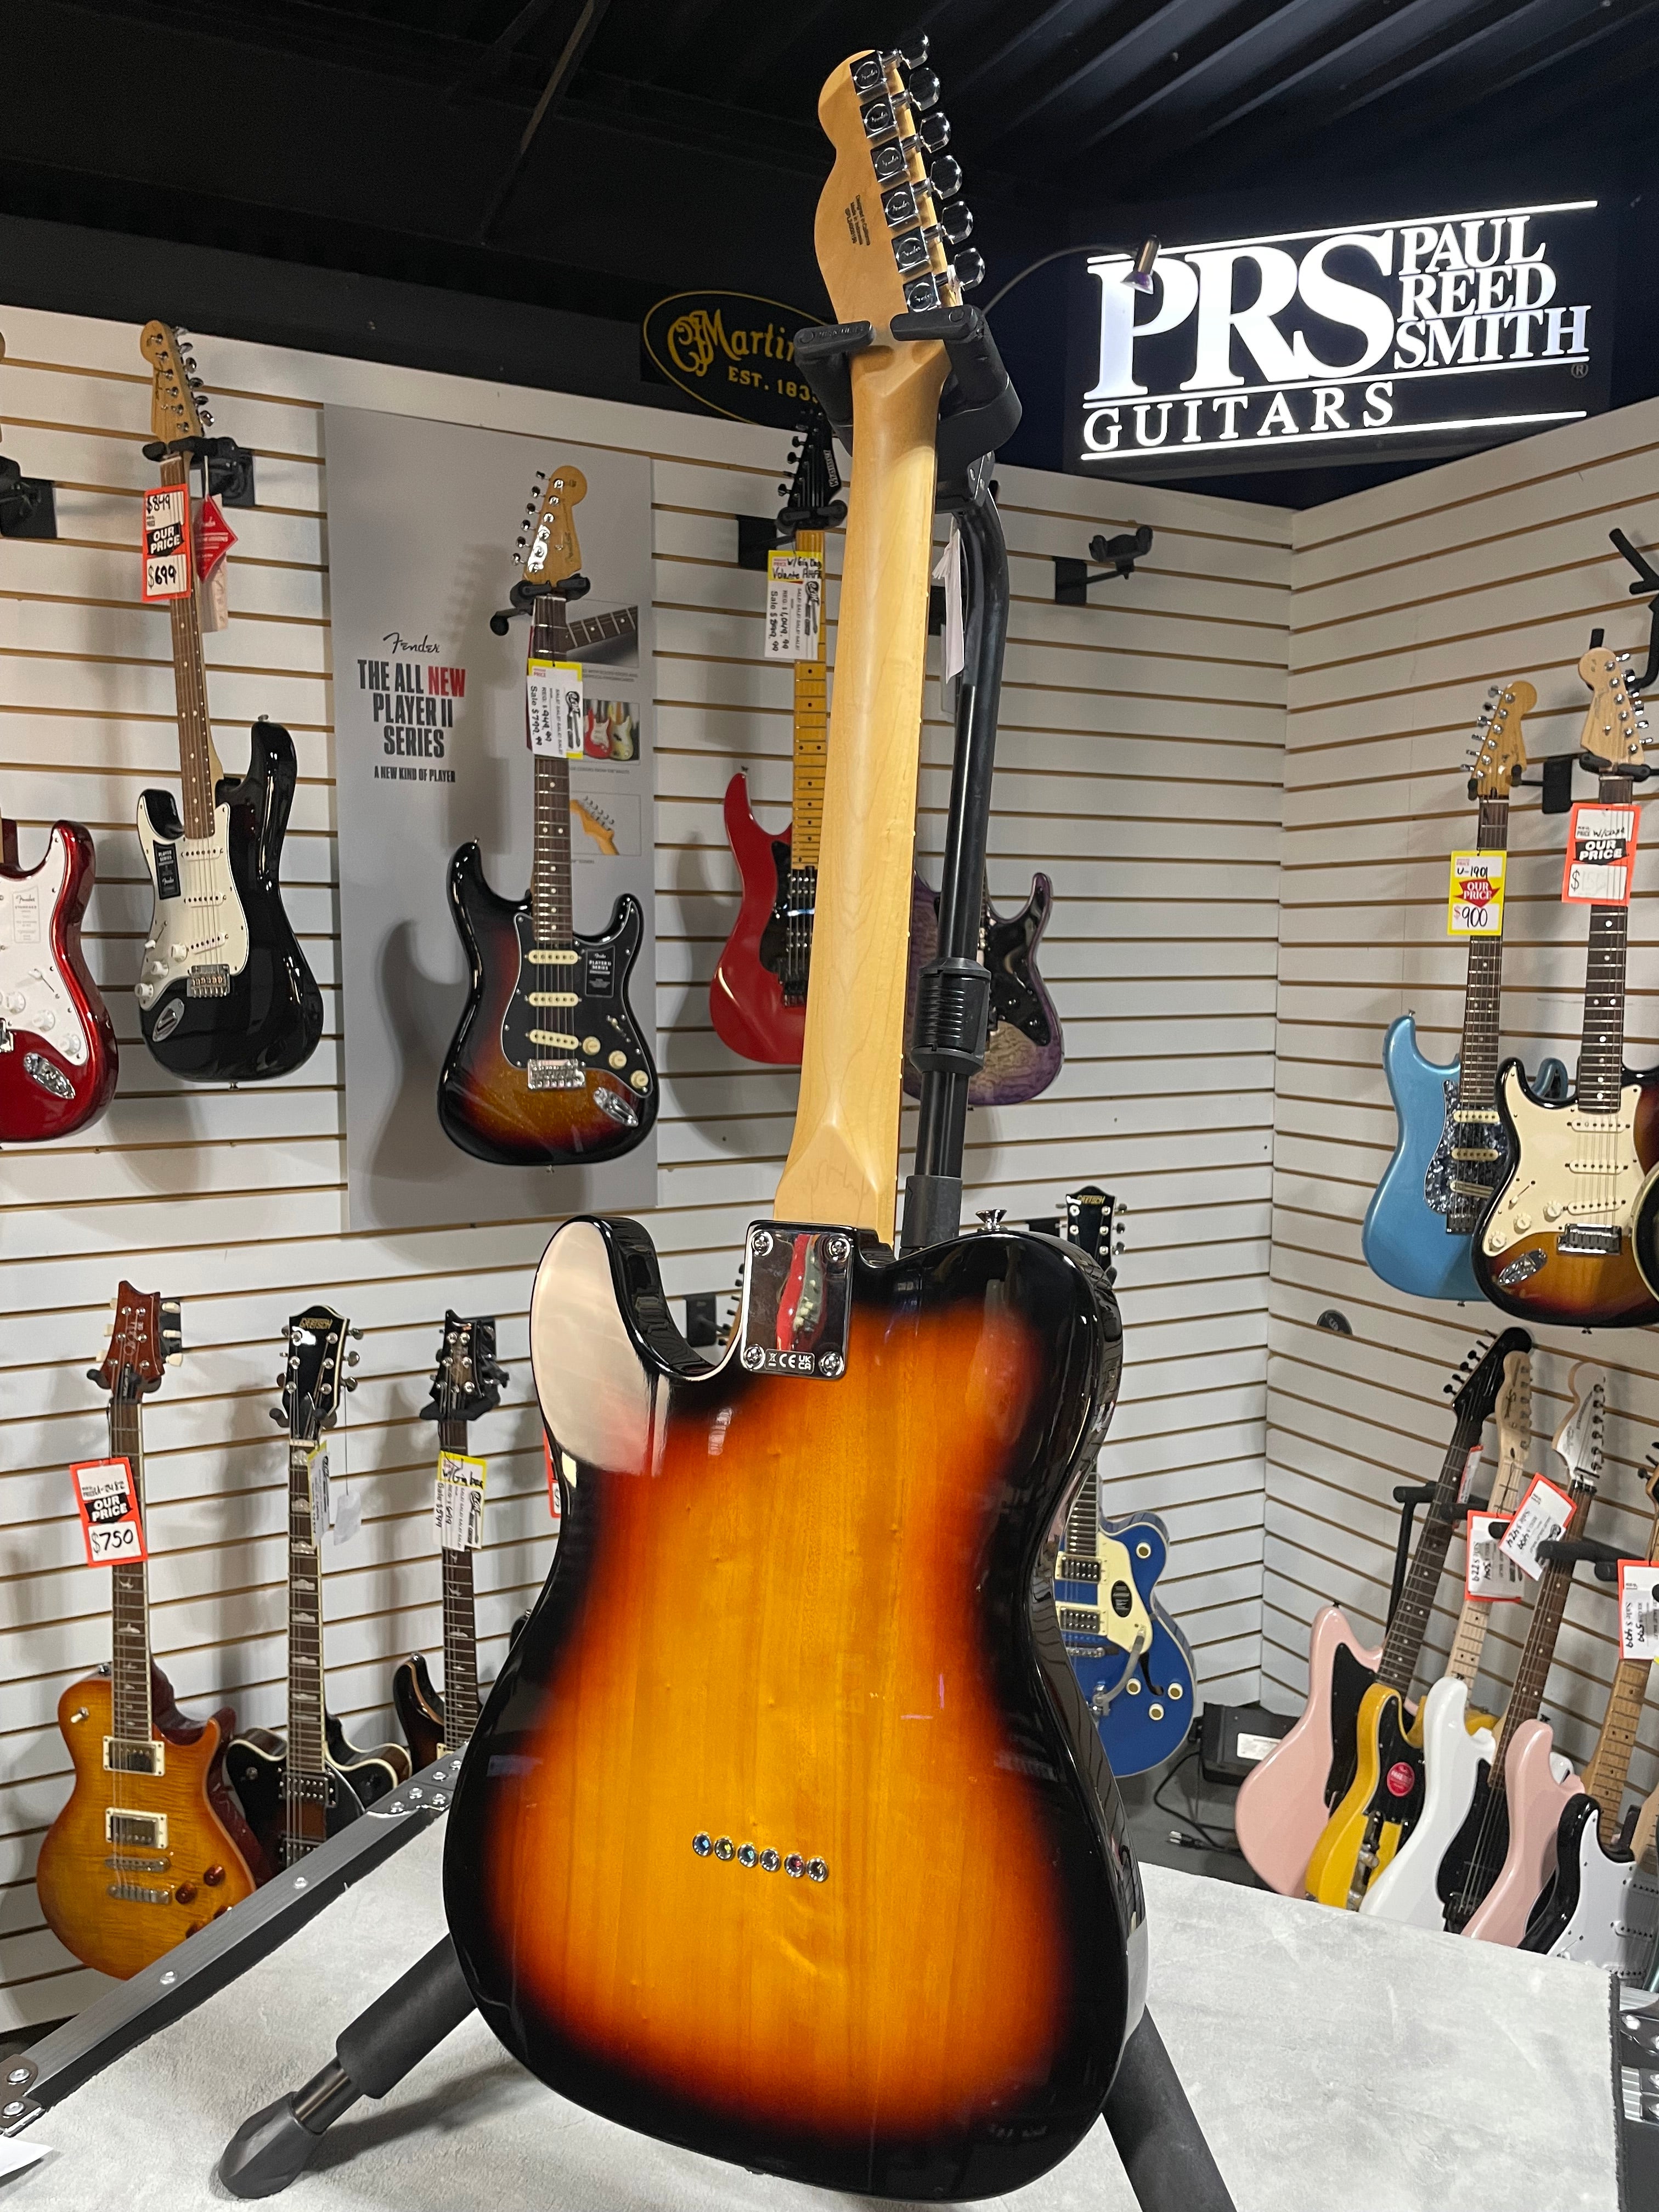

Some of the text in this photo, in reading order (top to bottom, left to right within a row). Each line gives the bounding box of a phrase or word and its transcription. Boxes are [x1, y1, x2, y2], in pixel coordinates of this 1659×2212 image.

[1399, 215, 1546, 276] PAUL
[1397, 260, 1557, 324] REED
[1084, 230, 1395, 400] PRS
[1394, 304, 1592, 371] SMITH
[728, 365, 819, 404] EST. 183
[1082, 381, 1395, 453] GUITARS
[146, 494, 171, 515] $849
[153, 526, 175, 541] OUR
[150, 534, 180, 555] PRICE
[148, 565, 177, 590] $699
[770, 591, 778, 610] Sale
[383, 632, 440, 654] Fender
[357, 659, 466, 697] THE ALL NEW
[373, 692, 453, 728] PLAYER II
[383, 725, 445, 759] SERIES
[374, 765, 455, 782] A NEW KIND OF PLAYER
[1579, 848, 1623, 861] PRICE
[1585, 839, 1617, 851] OUR
[1463, 890, 1492, 900] PRICE
[1466, 881, 1489, 891] OUR
[1453, 905, 1488, 928] $900
[798, 1355, 812, 1363] UK
[798, 1362, 811, 1370] CA
[92, 1503, 128, 1522] PRICE
[93, 1495, 120, 1510] OUR
[92, 1528, 134, 1554] $750
